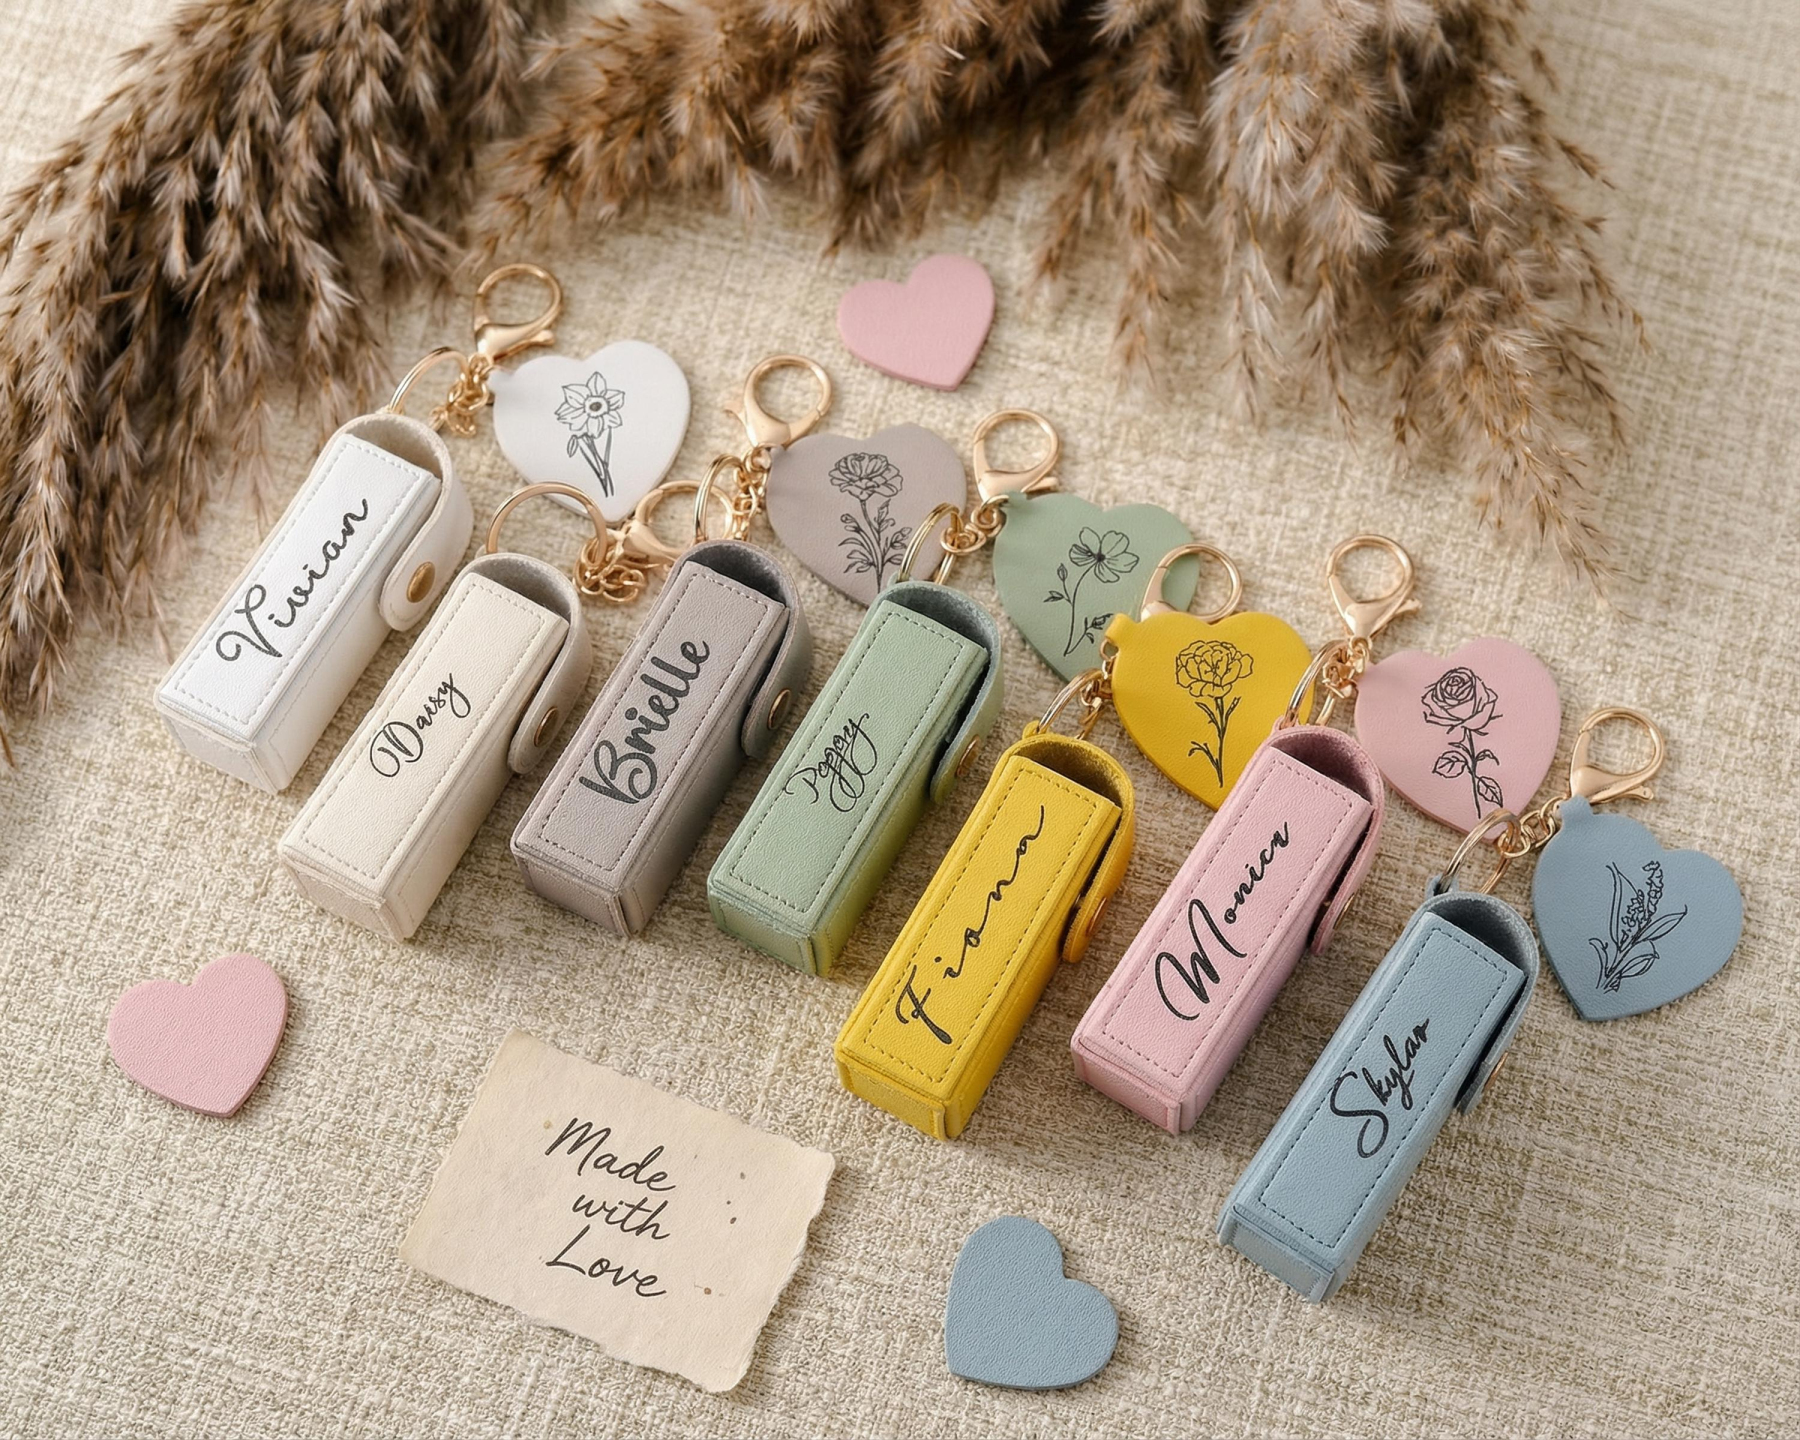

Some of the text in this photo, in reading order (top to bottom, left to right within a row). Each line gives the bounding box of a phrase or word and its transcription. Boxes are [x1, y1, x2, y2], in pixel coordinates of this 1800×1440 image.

[215, 498, 369, 662] Vivian
[369, 672, 471, 778] Daisy
[578, 639, 711, 805] Brielle
[894, 804, 1047, 1046] Fiona
[1154, 820, 1290, 1022] Monica
[544, 1117, 676, 1192] Made
[1329, 1017, 1431, 1160] Skylar
[545, 1224, 667, 1298] Love
[571, 1194, 670, 1240] with
